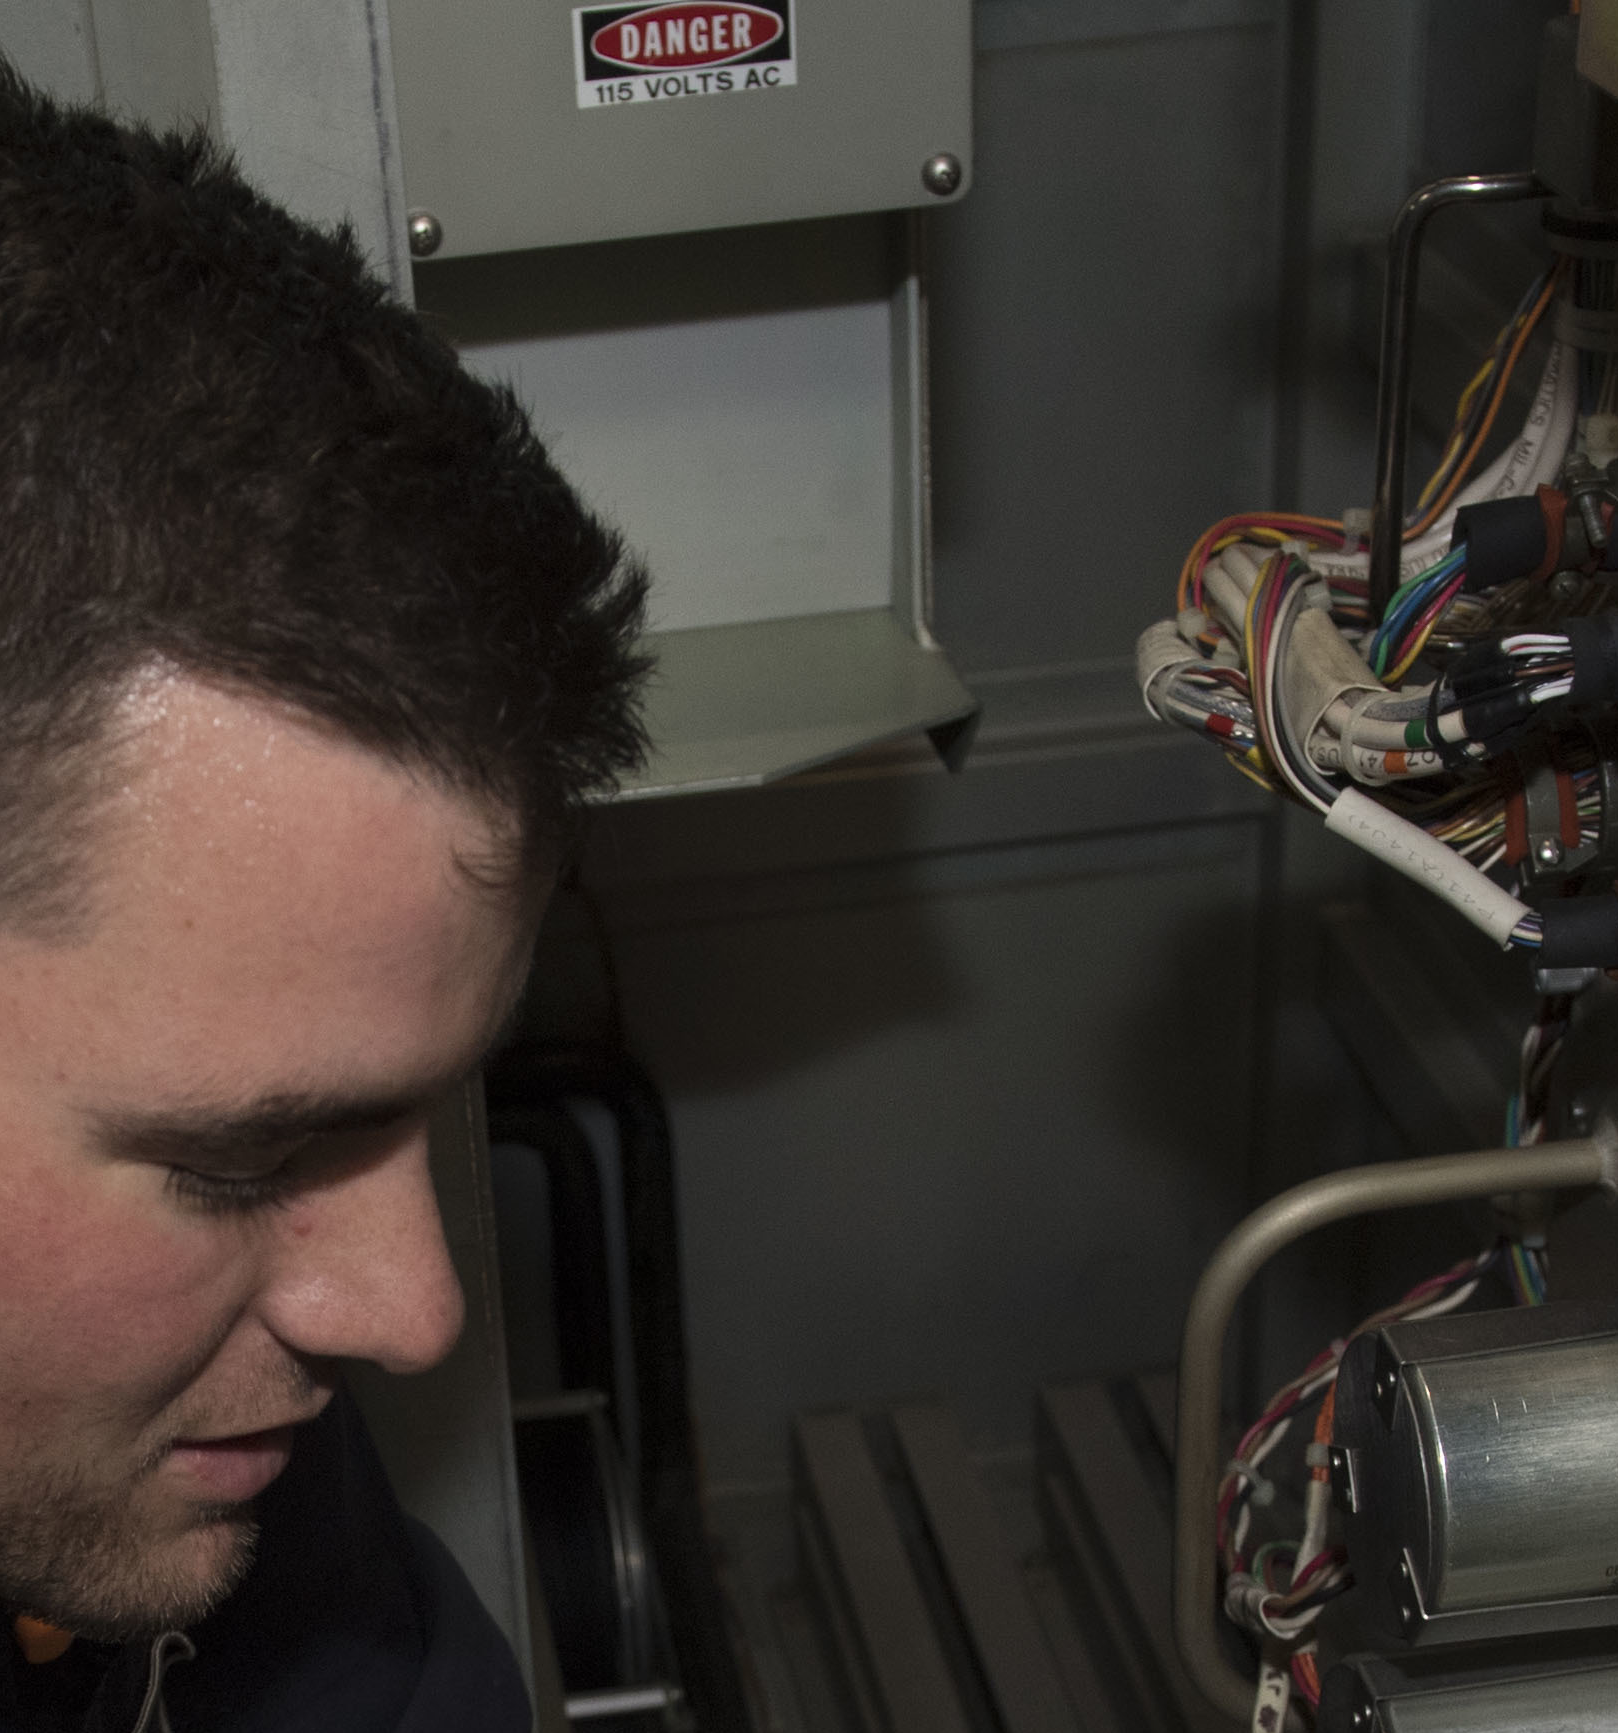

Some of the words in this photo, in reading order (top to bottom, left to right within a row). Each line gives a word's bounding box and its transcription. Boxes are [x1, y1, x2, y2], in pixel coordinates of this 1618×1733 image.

[620, 13, 753, 60] DANGER
[596, 82, 634, 104] 115
[644, 70, 734, 99] VOLTS
[744, 66, 781, 89] AC
